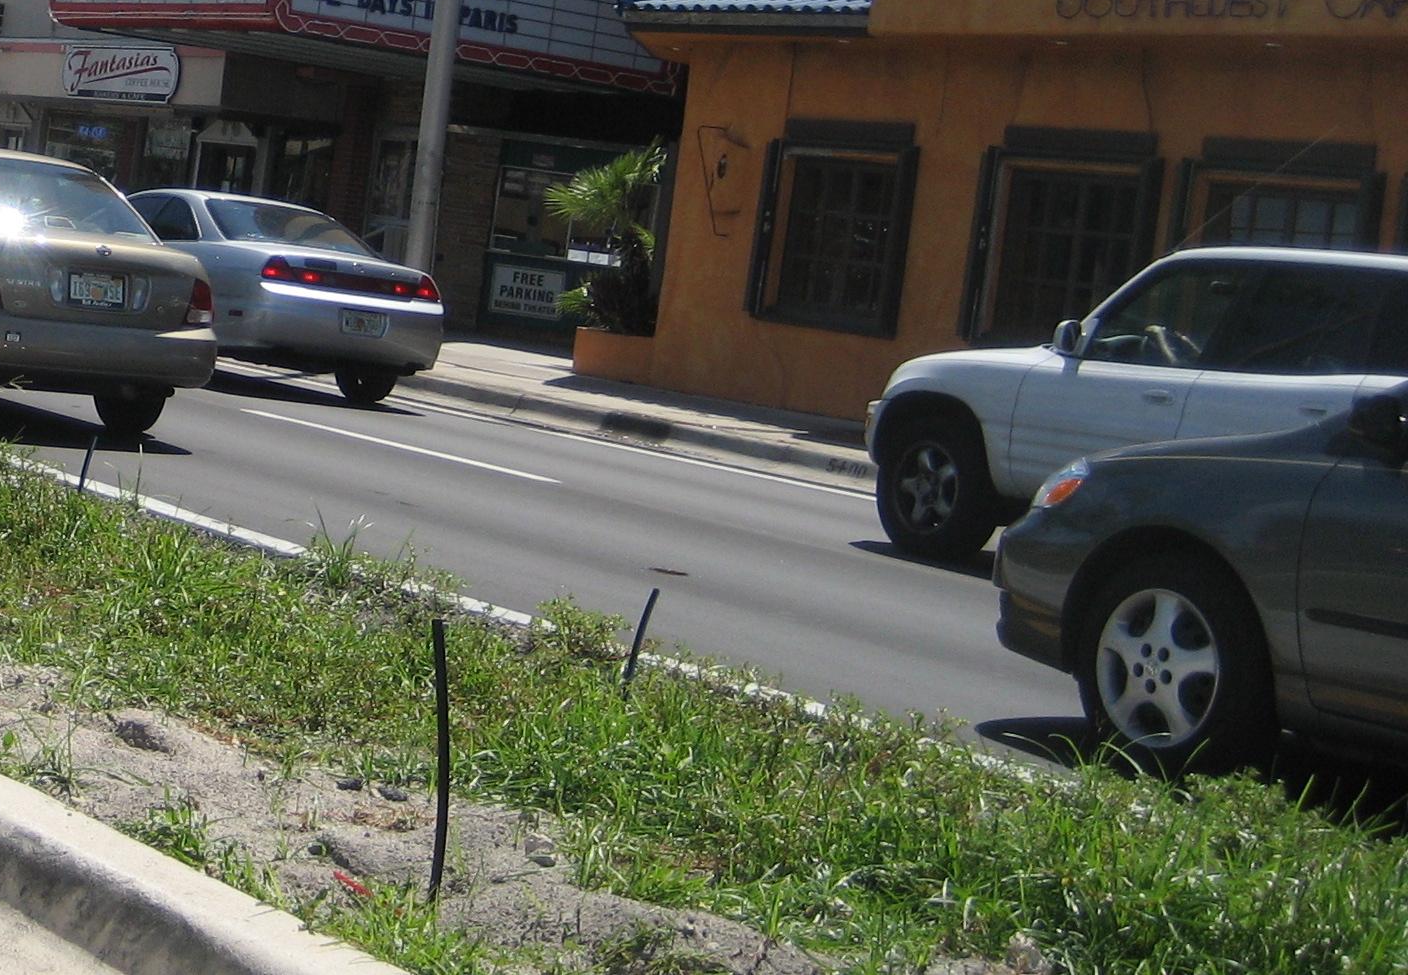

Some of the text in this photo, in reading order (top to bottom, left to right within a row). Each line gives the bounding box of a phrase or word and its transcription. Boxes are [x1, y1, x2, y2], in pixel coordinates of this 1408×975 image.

[460, 4, 519, 35] PARIS
[512, 271, 545, 287] FREE
[499, 284, 554, 303] PARKING
